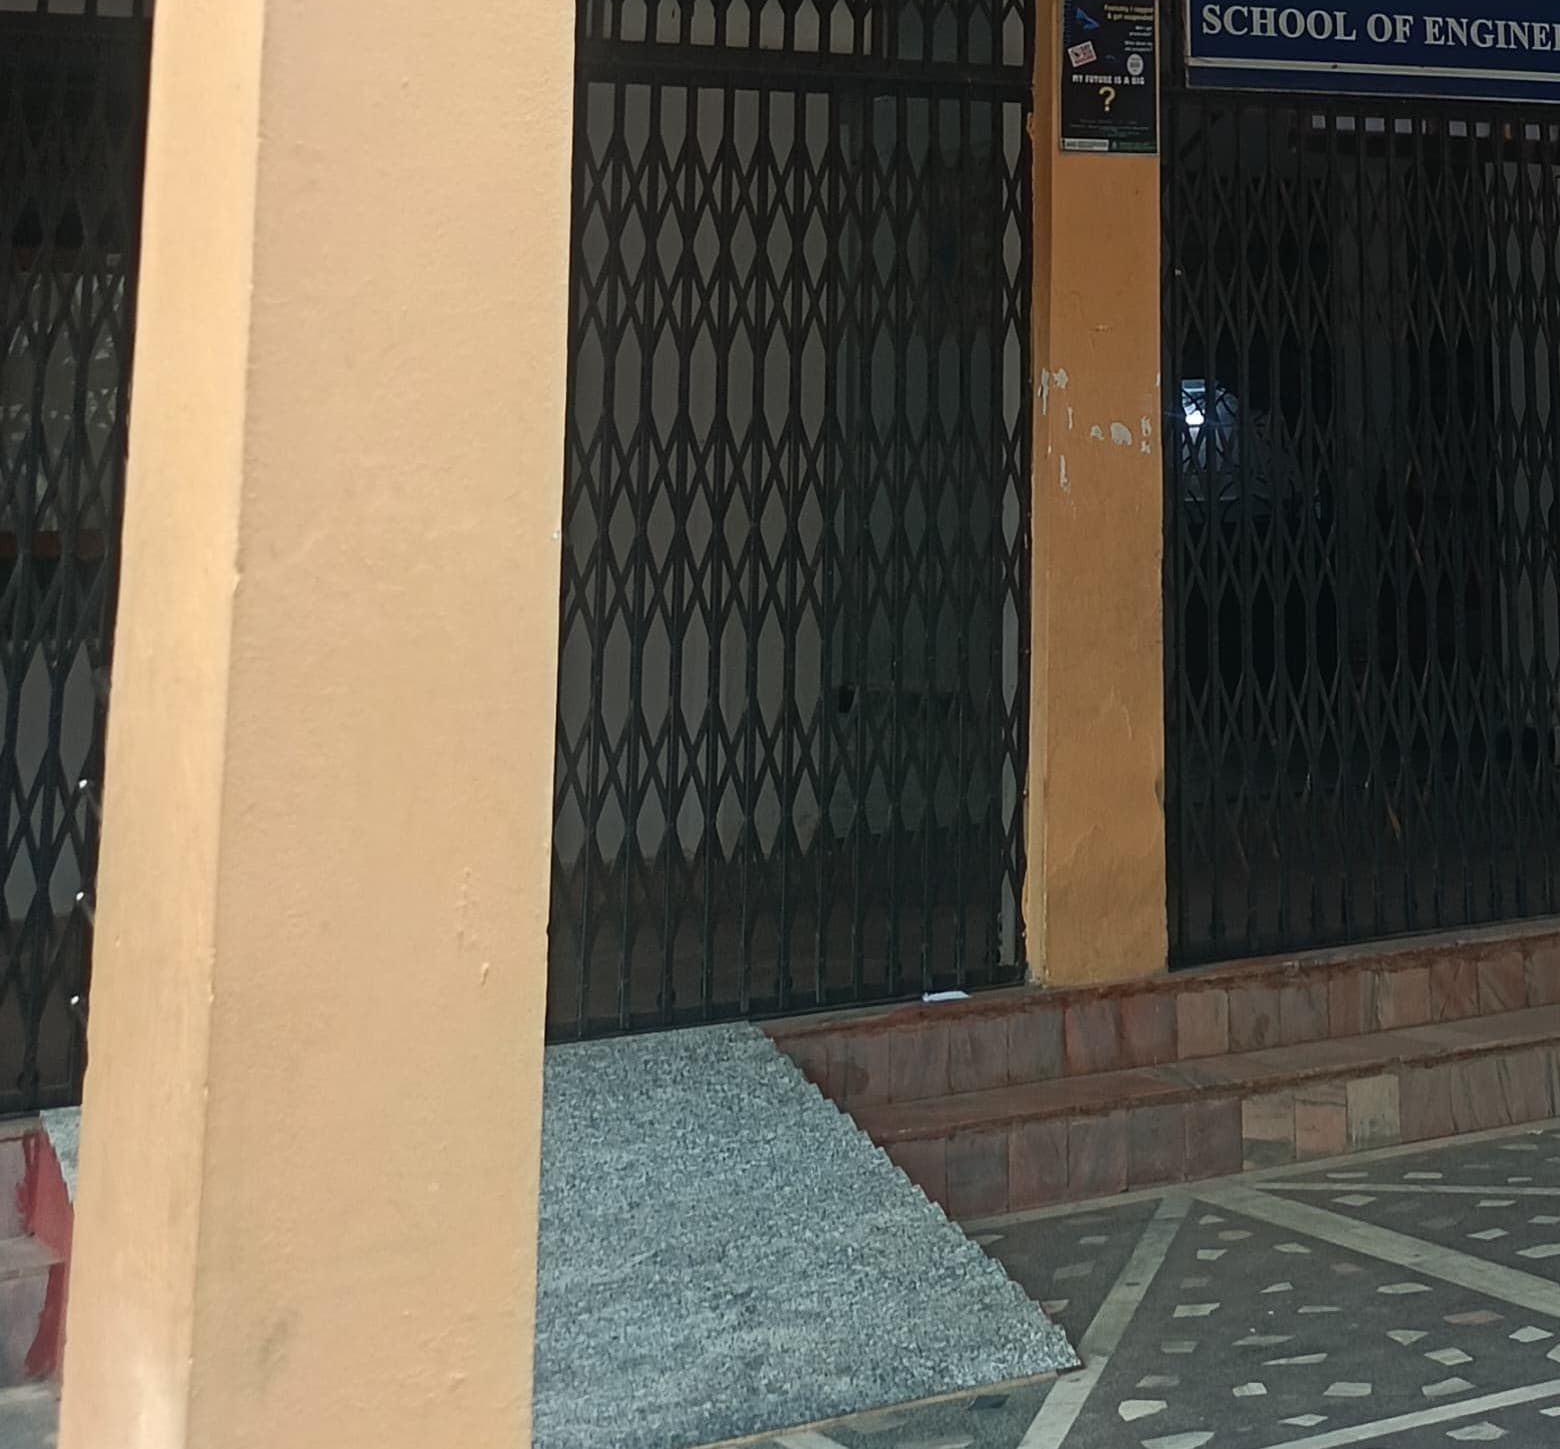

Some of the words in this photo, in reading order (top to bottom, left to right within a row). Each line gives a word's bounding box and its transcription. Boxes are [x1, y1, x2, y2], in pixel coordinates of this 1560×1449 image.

[1202, 4, 1357, 41] SCHOOL
[1366, 13, 1414, 44] OF
[1085, 74, 1112, 85] FUTURE
[1114, 75, 1122, 85] IS
[1123, 76, 1130, 85] A
[1099, 86, 1116, 112] ?
